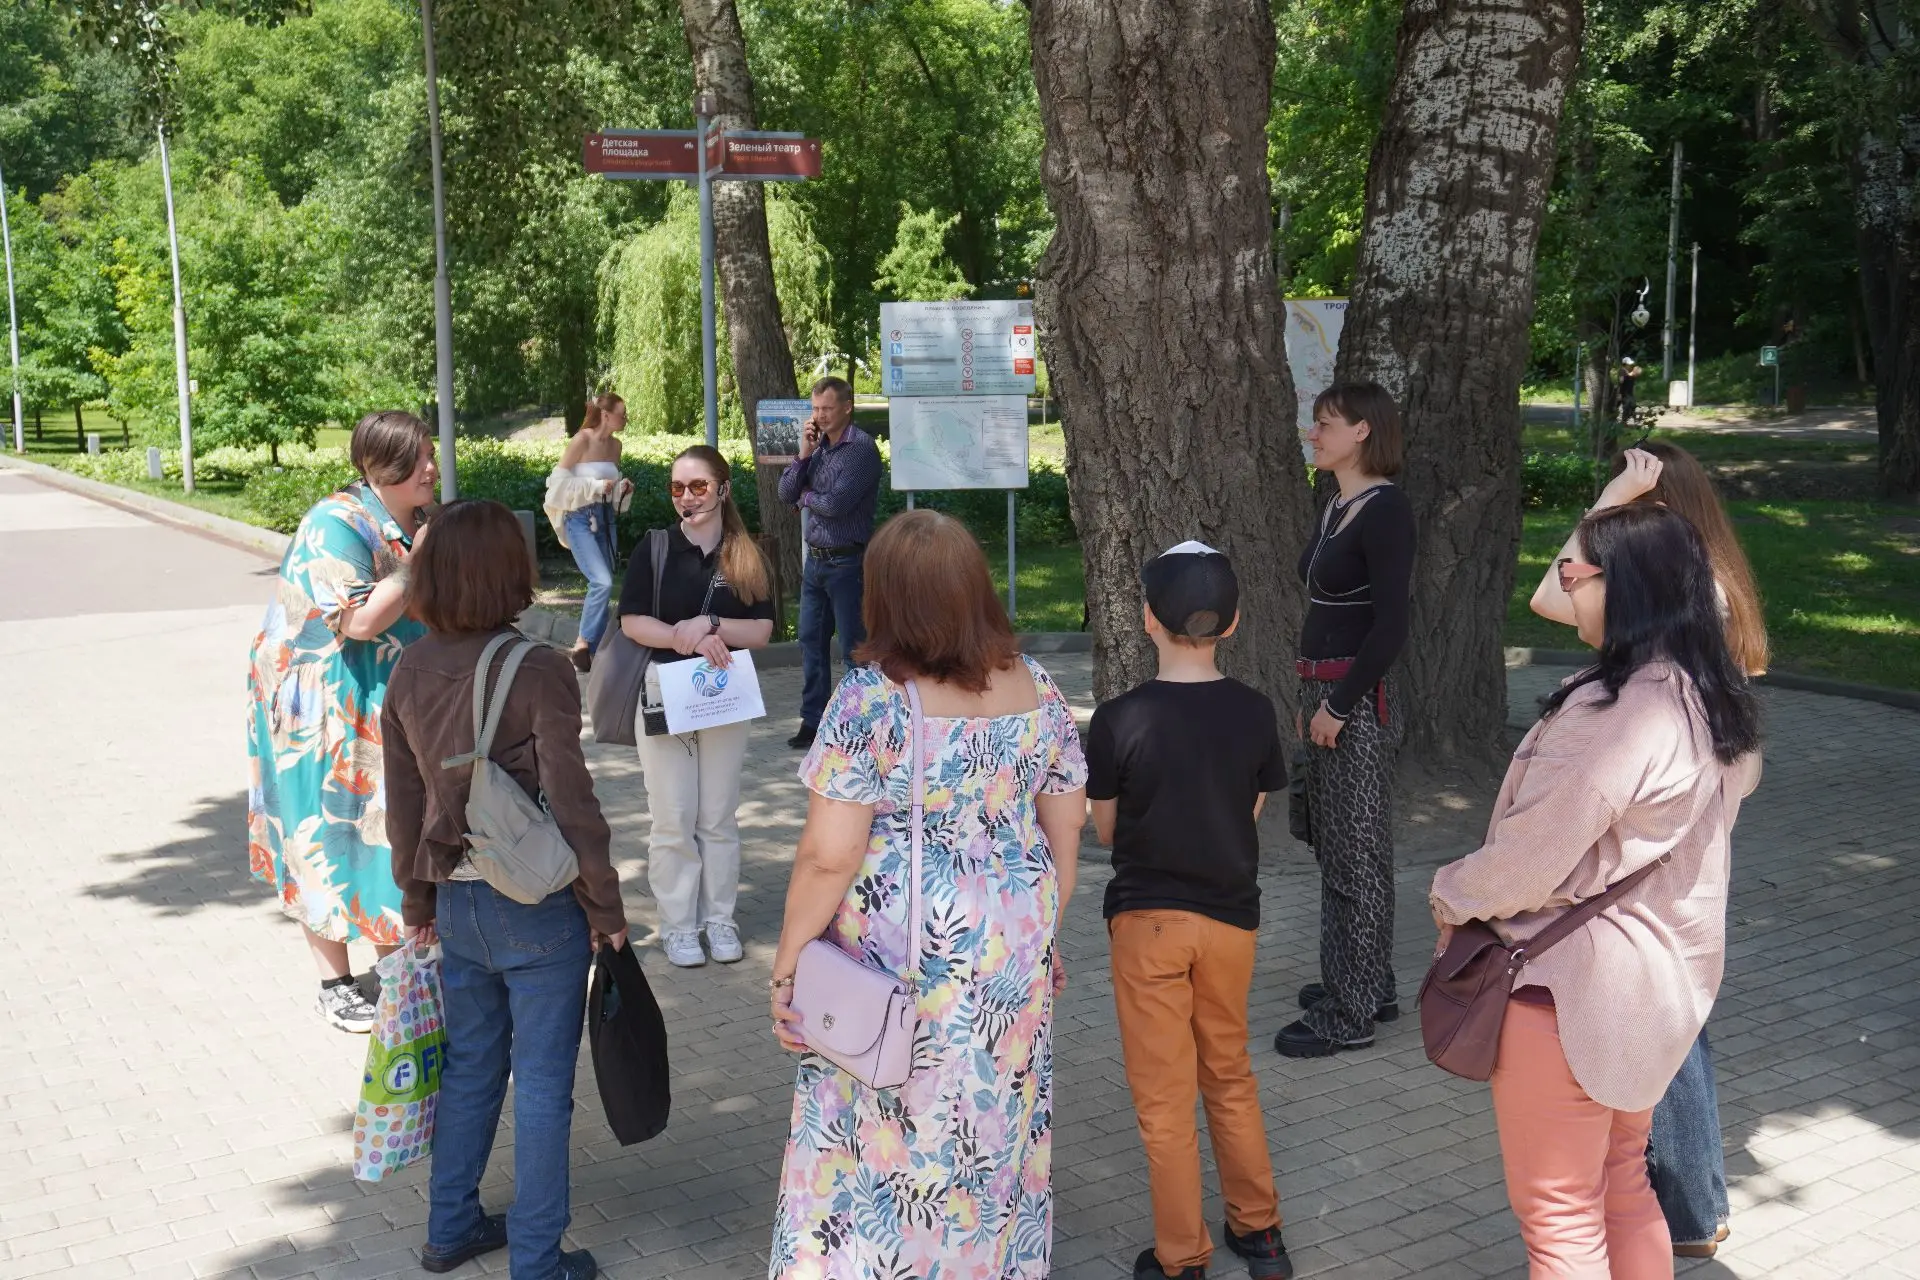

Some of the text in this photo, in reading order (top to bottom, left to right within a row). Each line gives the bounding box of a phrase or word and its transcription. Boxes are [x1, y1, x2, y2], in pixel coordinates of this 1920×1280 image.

[602, 138, 638, 148] Детская
[602, 148, 649, 157] площадка
[728, 142, 801, 155] Зеленый театр
